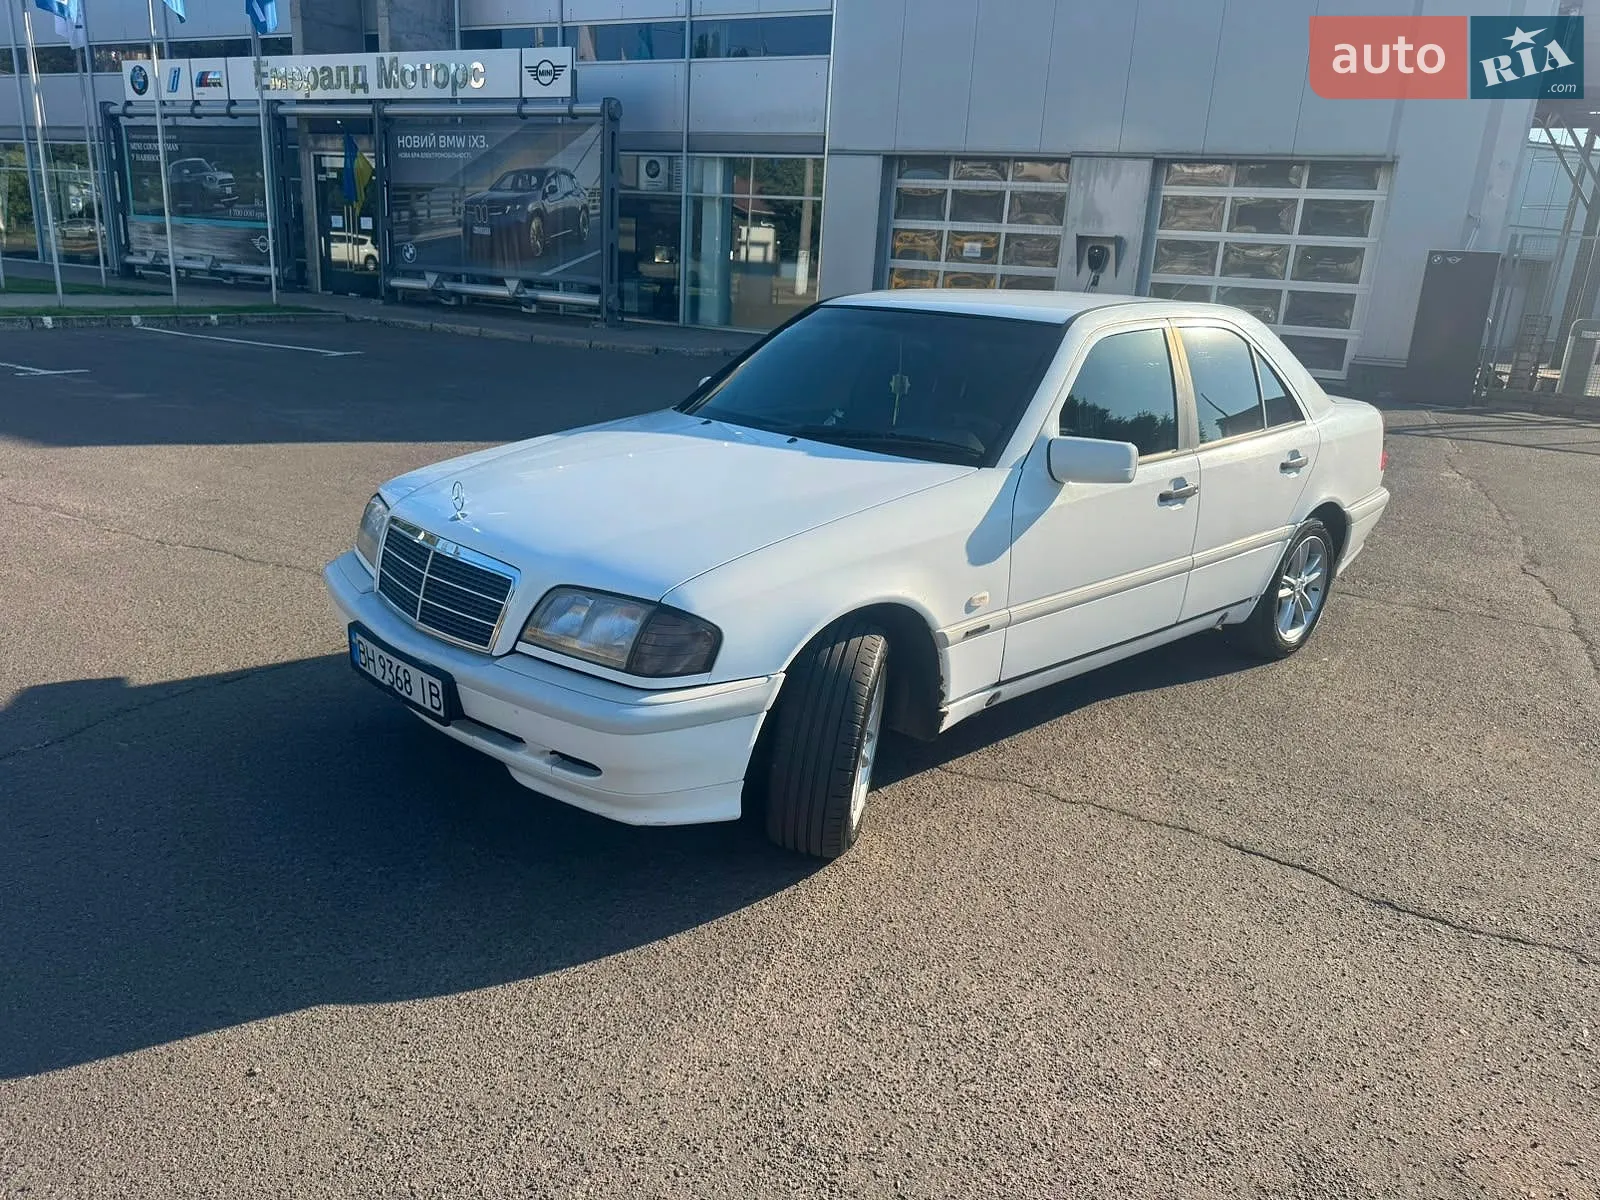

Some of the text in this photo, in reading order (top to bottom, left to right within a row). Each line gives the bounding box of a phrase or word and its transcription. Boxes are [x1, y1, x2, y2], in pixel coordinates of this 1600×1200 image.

[376, 56, 486, 97] Моторс
[538, 69, 553, 77] MINI
[397, 132, 436, 148] НОВИЙ
[438, 135, 466, 148] BMW
[357, 639, 442, 712] BH 9368 IB
